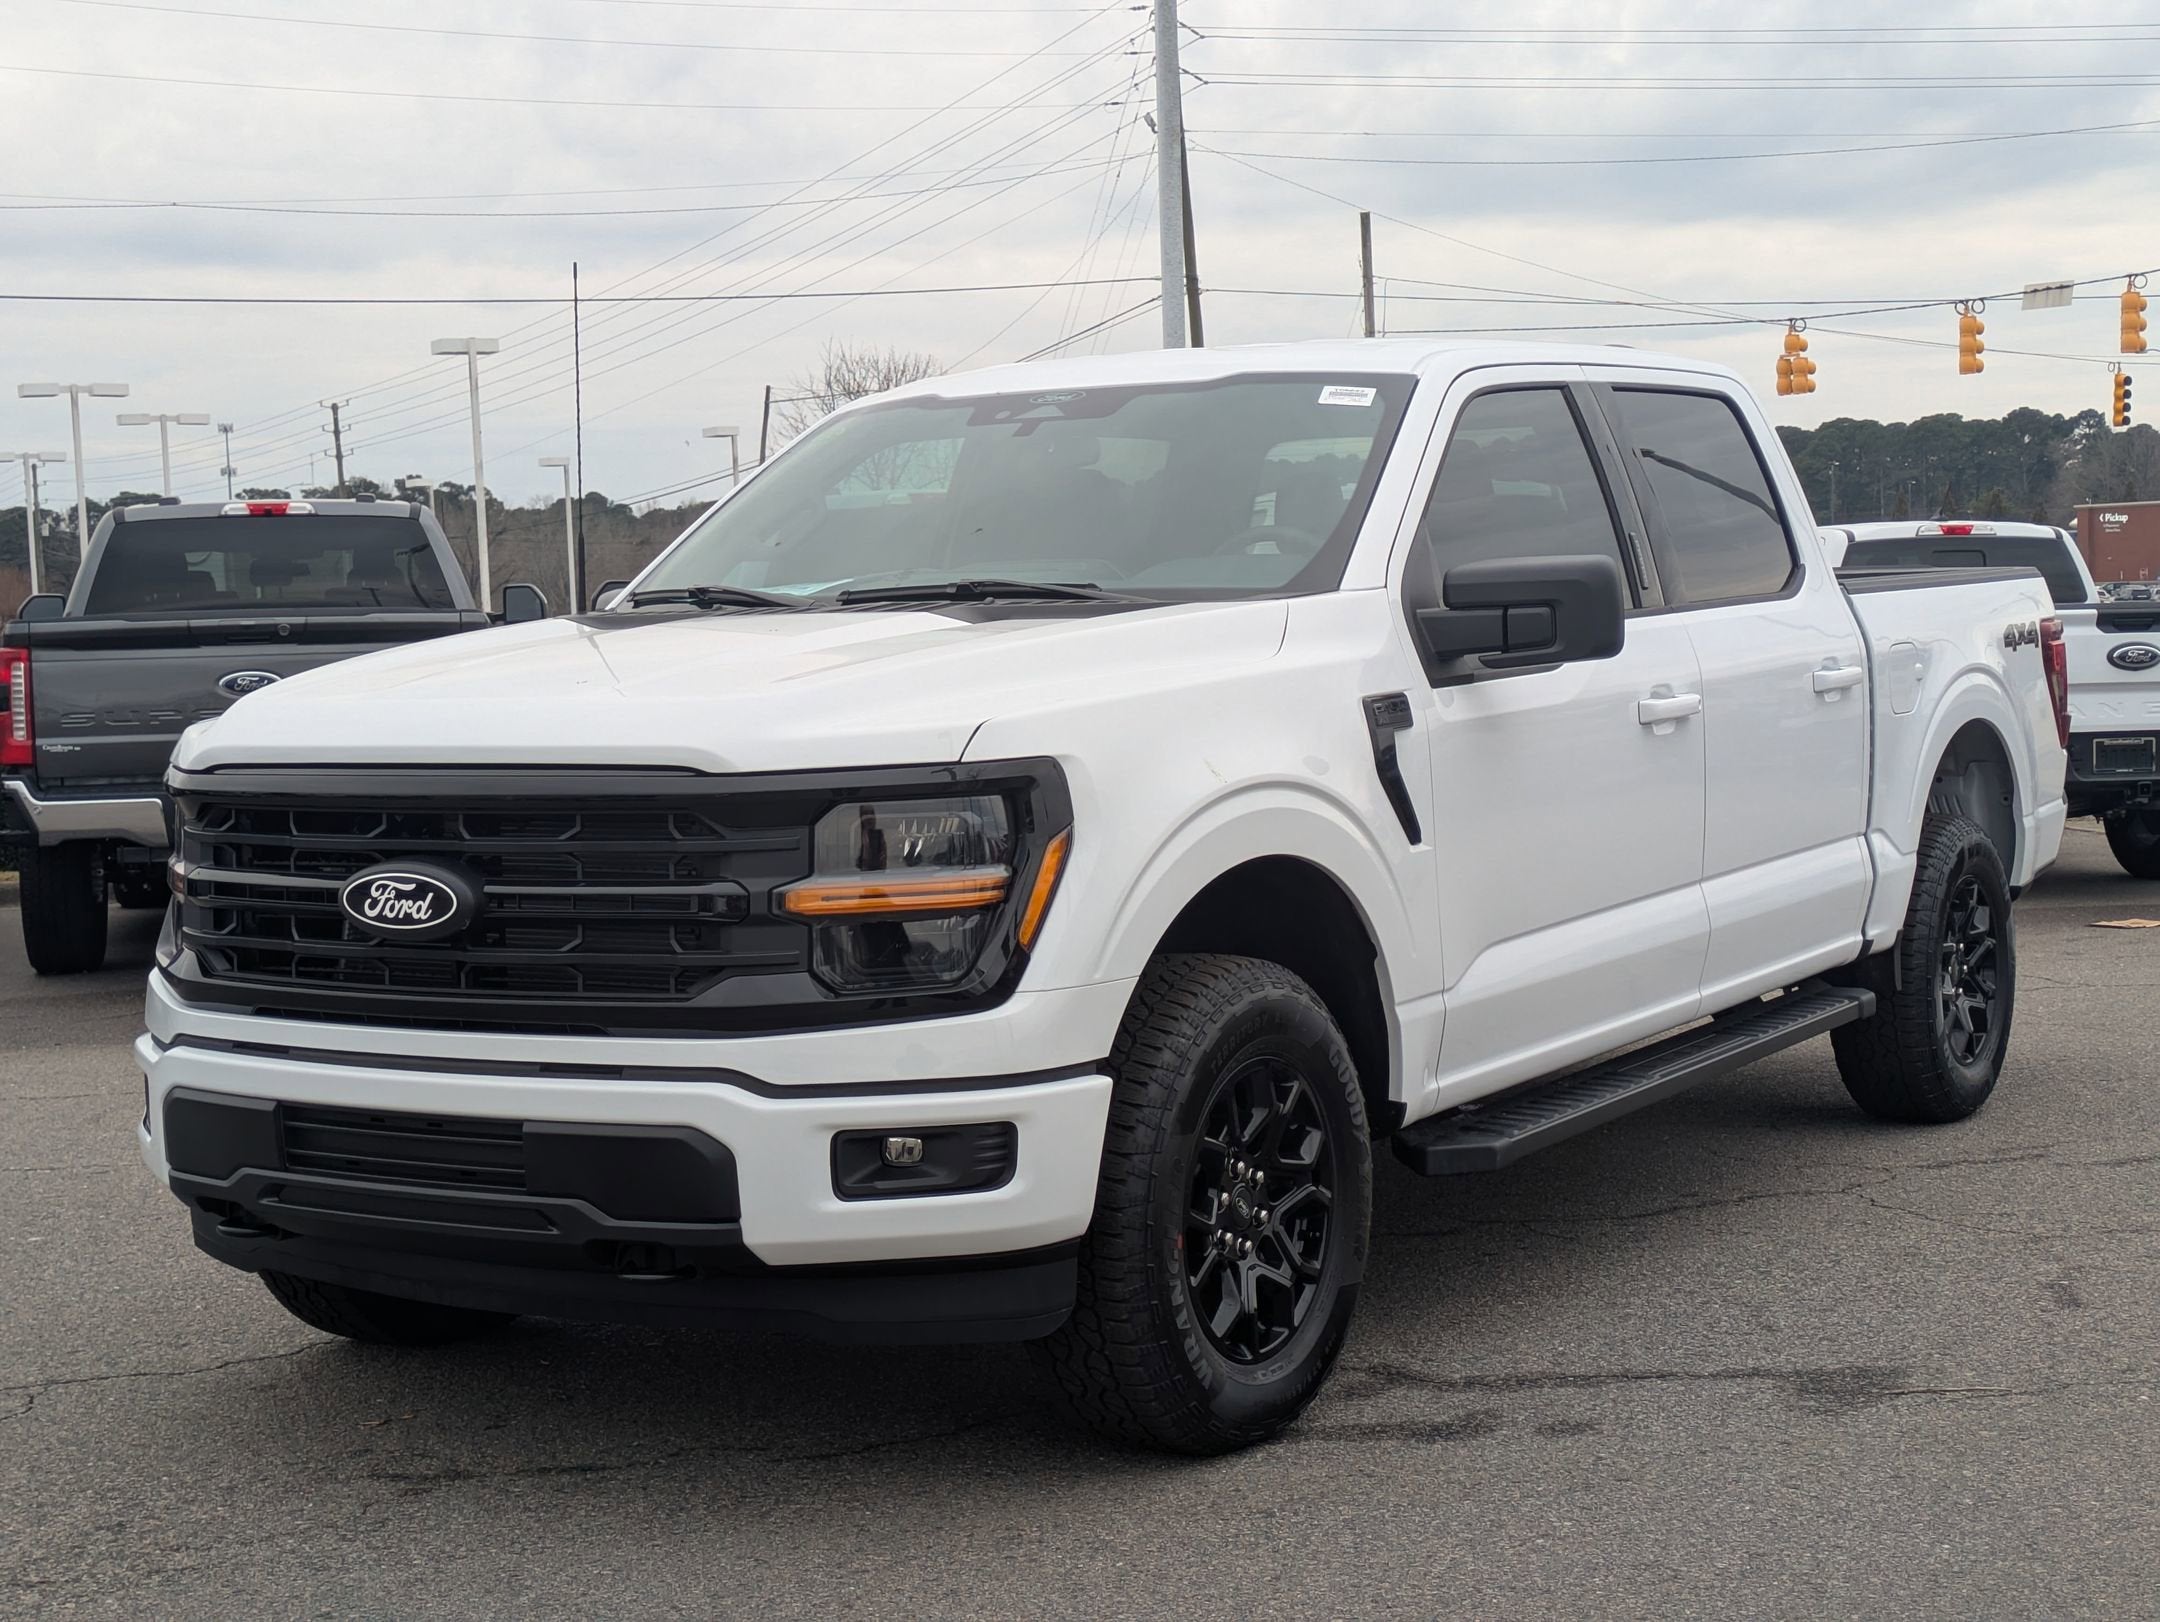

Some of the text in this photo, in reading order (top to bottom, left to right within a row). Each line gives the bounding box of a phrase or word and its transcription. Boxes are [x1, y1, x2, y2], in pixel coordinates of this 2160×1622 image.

[2105, 512, 2129, 524] Pickup
[2125, 649, 2152, 663] Ford
[363, 879, 435, 921] Ford
